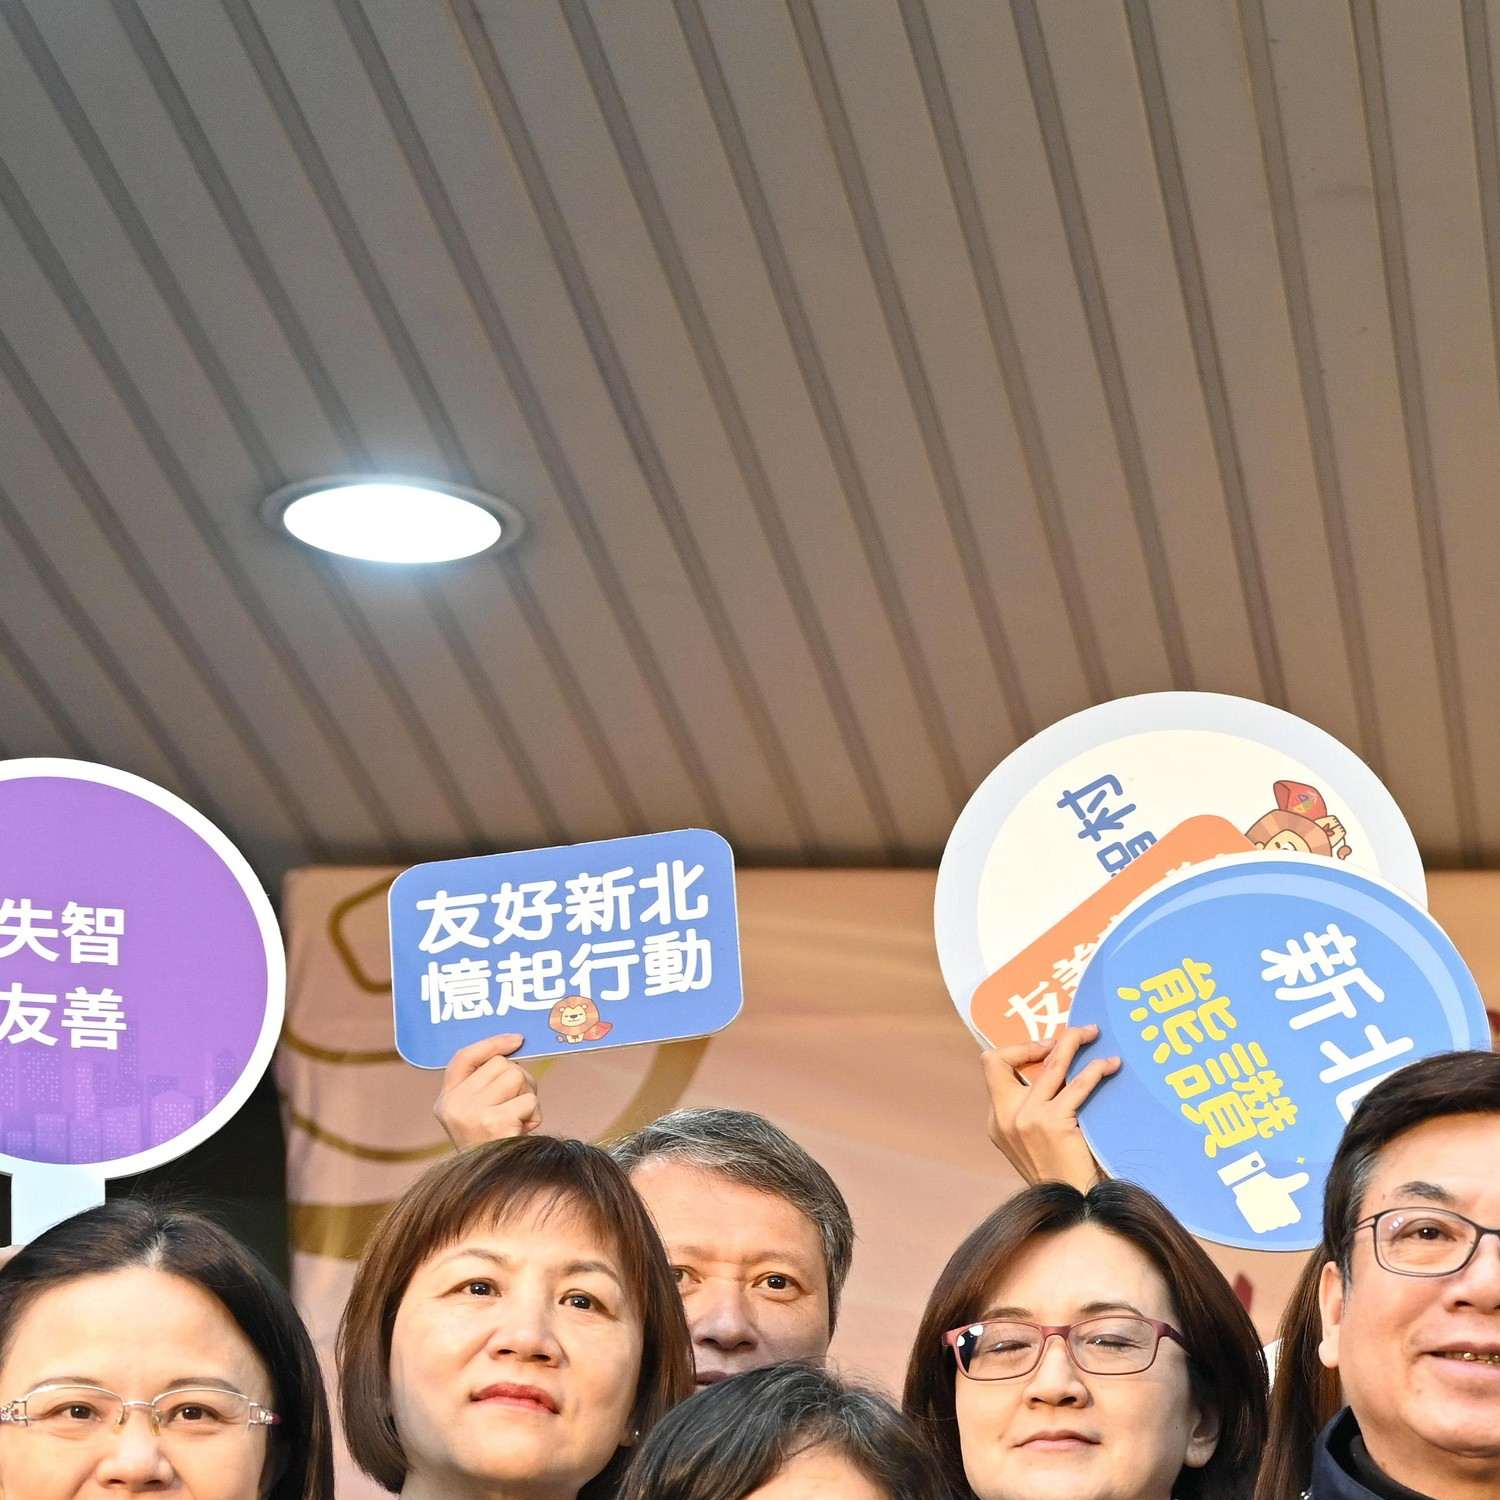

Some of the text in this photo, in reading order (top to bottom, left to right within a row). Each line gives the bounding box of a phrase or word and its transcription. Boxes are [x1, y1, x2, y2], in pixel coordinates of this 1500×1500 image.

[0, 898, 125, 966] 失智
[415, 859, 710, 954] 友好新北
[0, 982, 128, 1050] 友善
[420, 928, 713, 1024] 憶起行動
[1116, 957, 1300, 1159] 熊讚
